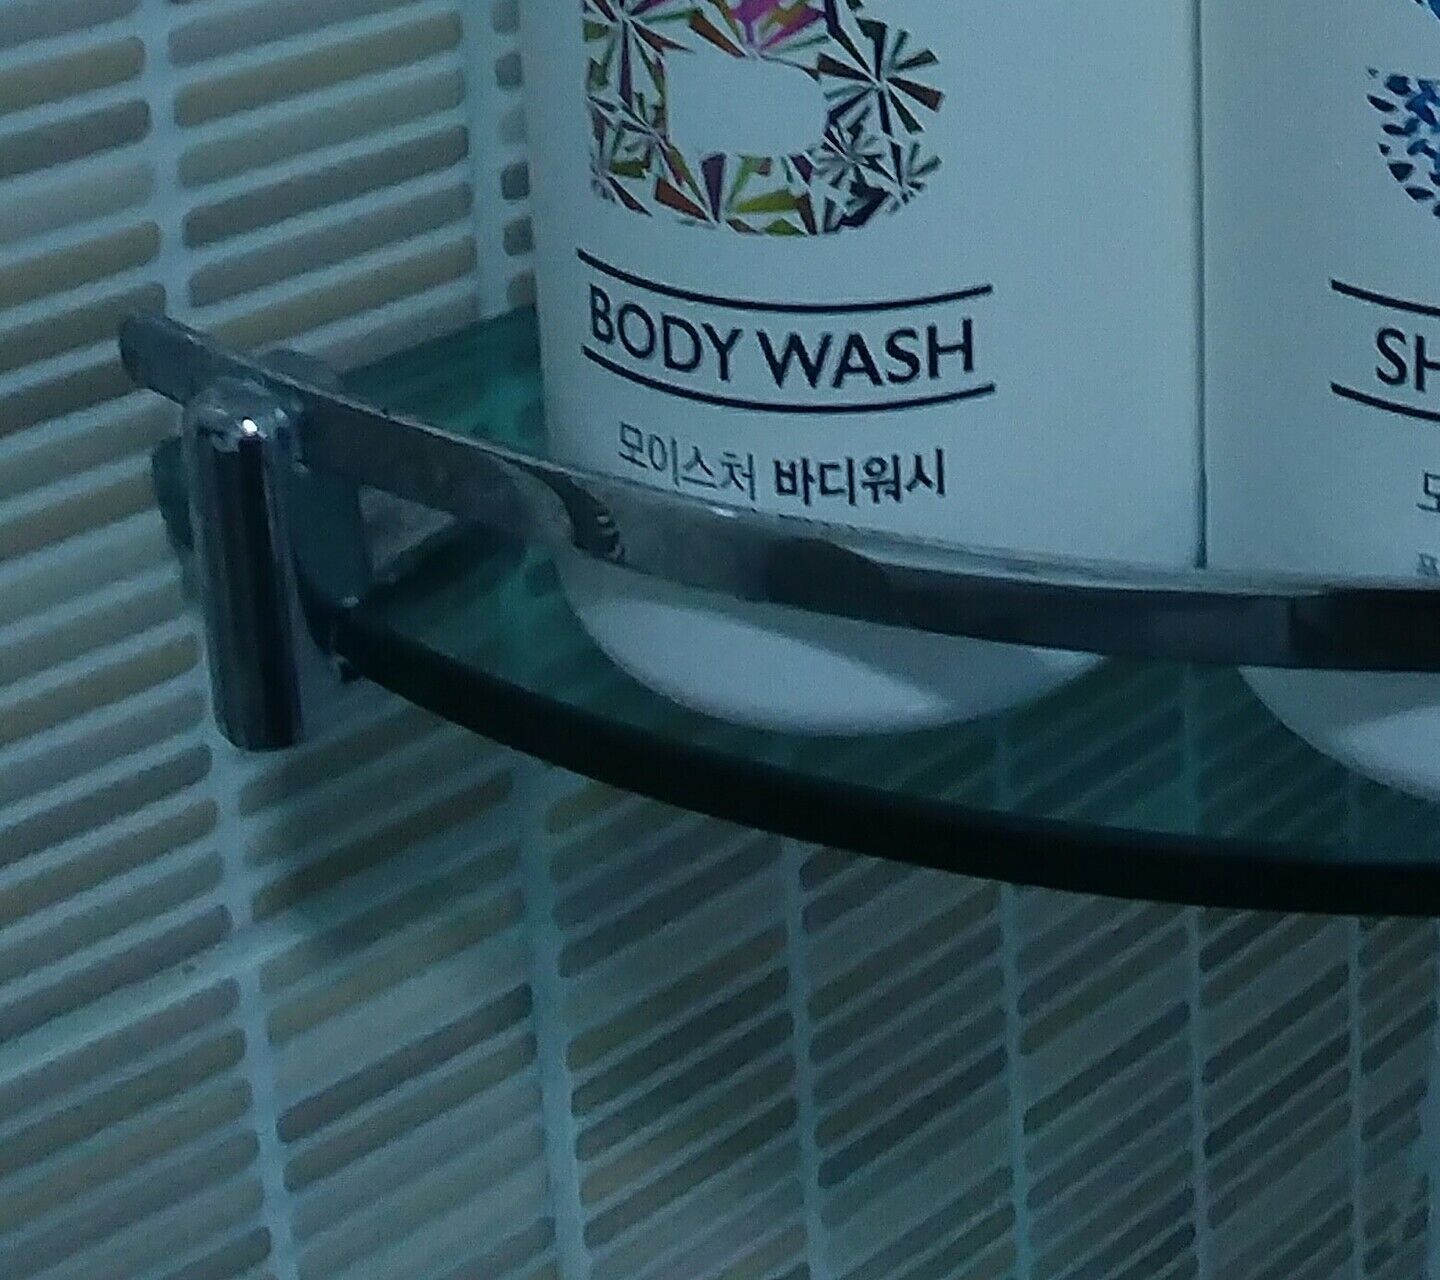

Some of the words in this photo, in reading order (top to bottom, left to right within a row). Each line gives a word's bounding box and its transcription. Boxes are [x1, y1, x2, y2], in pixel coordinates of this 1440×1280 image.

[589, 283, 742, 382] BODY
[757, 317, 976, 389] WASH
[618, 420, 756, 501] 모이스처
[774, 448, 946, 507] 바디워시
